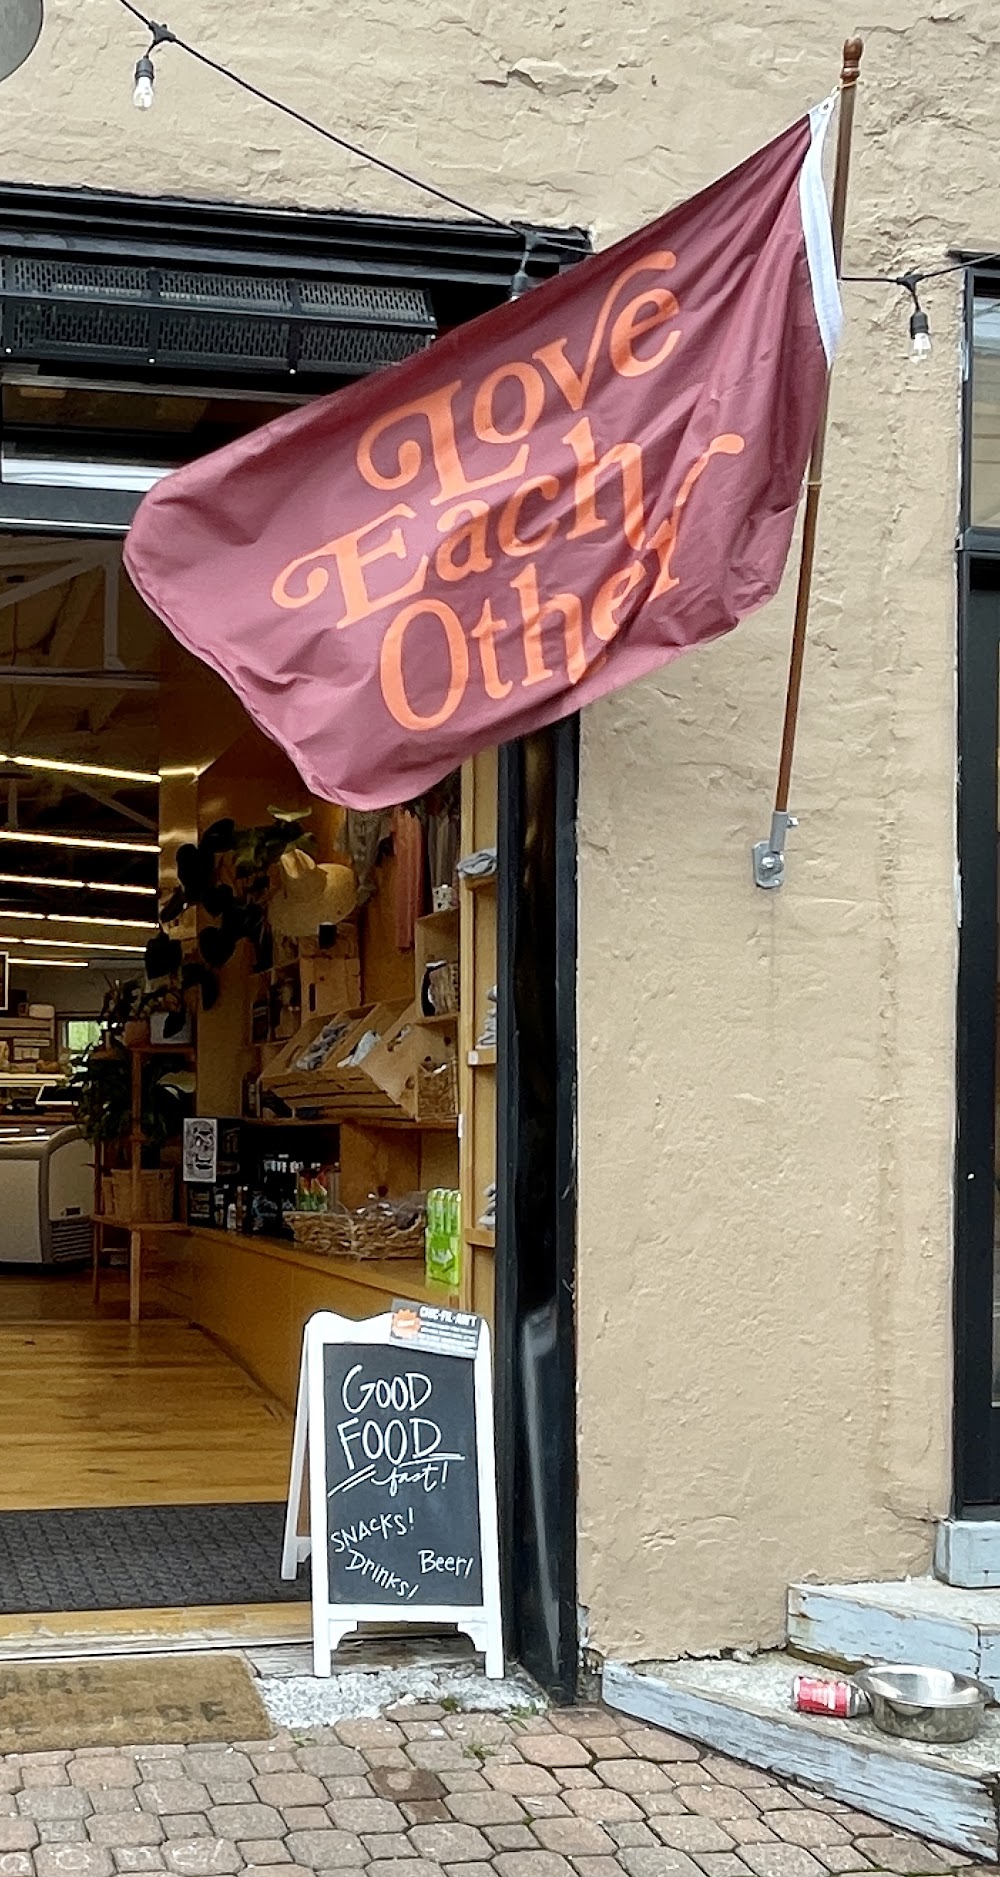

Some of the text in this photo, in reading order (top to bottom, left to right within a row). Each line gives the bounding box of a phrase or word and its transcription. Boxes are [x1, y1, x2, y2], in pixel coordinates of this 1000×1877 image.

[356, 250, 682, 505] Love
[271, 416, 652, 630] Each
[379, 433, 745, 730] Other
[341, 1364, 432, 1413] GOOD
[337, 1417, 442, 1470] FOOD
[370, 1460, 449, 1497] fast!
[330, 1506, 414, 1553] SNACKS!
